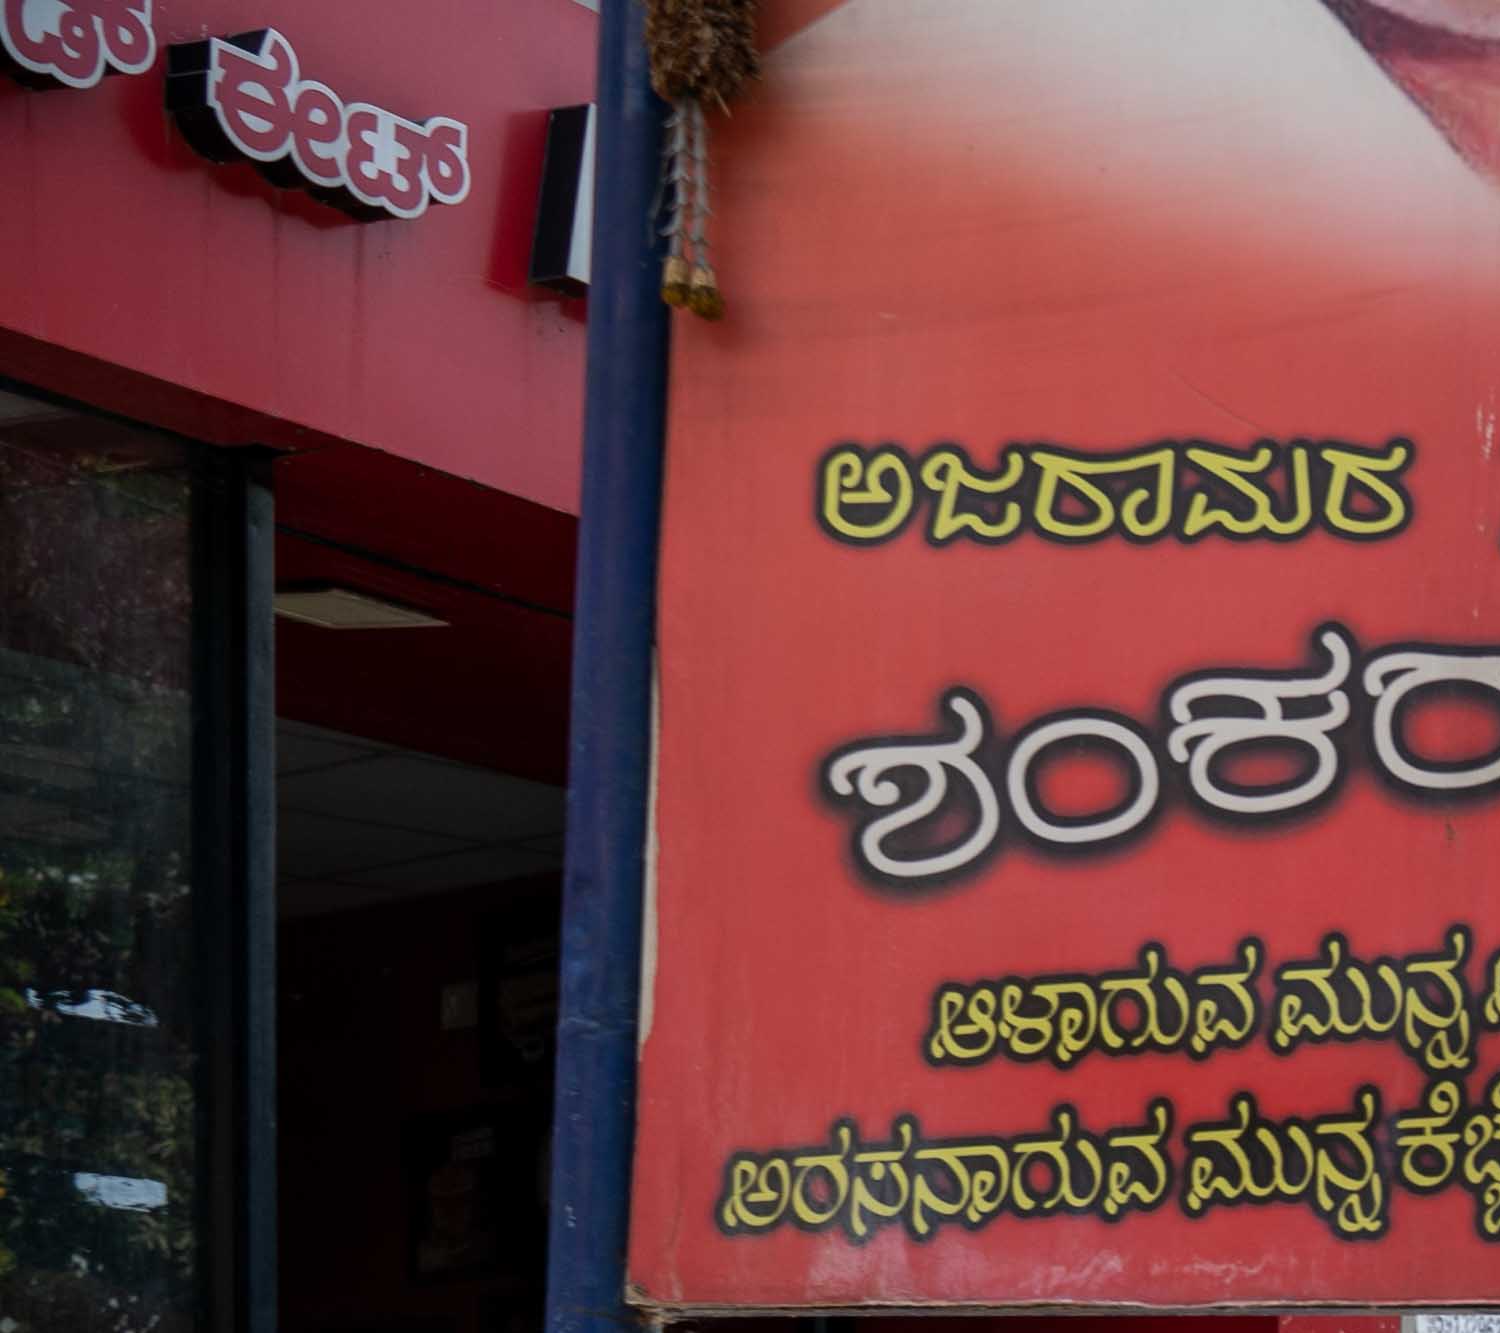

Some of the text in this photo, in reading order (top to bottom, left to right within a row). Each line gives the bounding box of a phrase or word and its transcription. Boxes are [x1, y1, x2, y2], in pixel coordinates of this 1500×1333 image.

[820, 440, 1411, 545] ಅಜರಾಮರ
[927, 942, 1260, 1065] ಆಳಾಗುವ
[1271, 927, 1473, 1073] ಮುನ್ನ
[719, 1102, 1170, 1237] ಅರಸನಾಗುವ
[1183, 1090, 1385, 1236] ಮುನ್ನ
